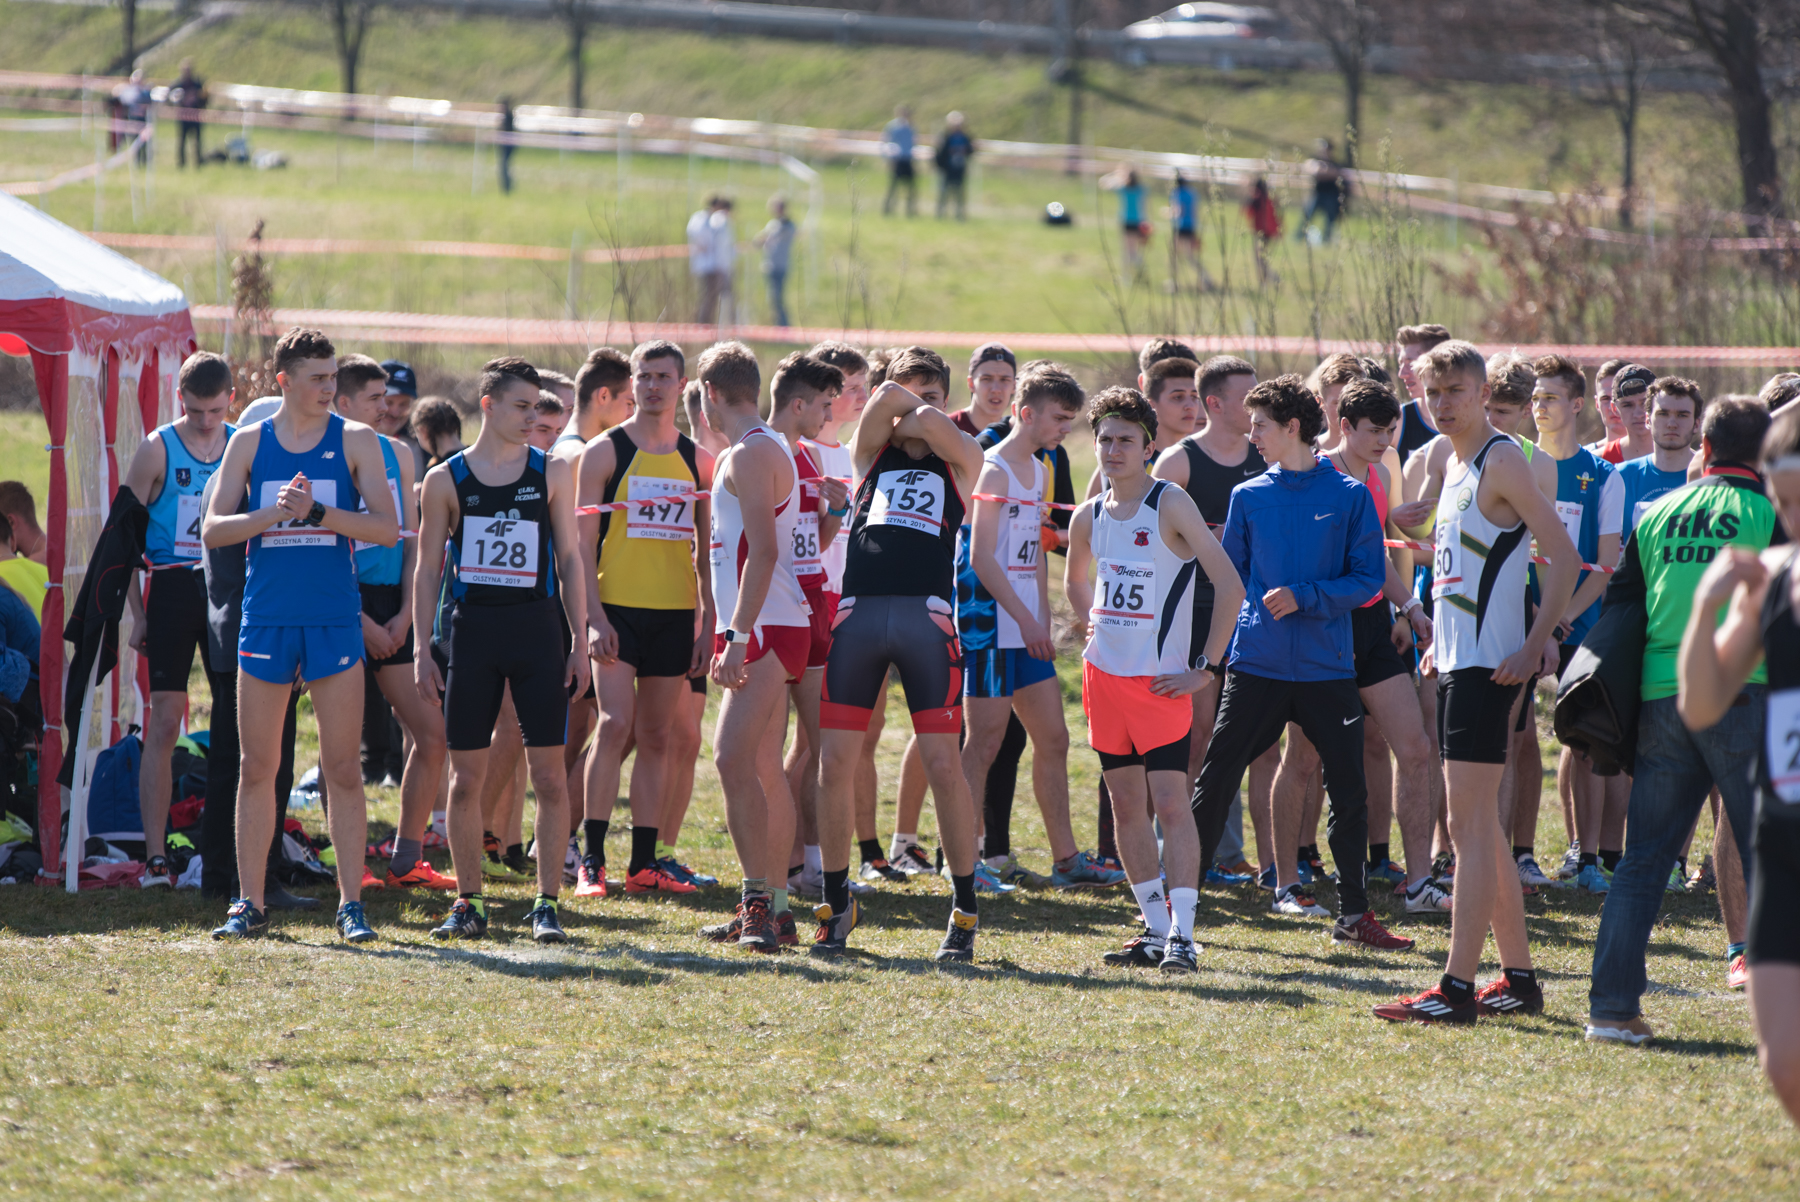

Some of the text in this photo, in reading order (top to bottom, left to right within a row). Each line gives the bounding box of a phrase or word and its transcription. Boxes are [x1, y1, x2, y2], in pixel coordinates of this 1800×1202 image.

[896, 471, 930, 486] 4F
[638, 499, 687, 524] 497
[885, 488, 935, 517] 152
[484, 520, 518, 537] 4F
[640, 530, 682, 540] OLSZYNA 2019
[910, 520, 926, 529] 2019
[1665, 508, 1741, 540] RKS
[475, 539, 527, 569] 128
[794, 532, 817, 558] 85
[1436, 547, 1453, 576] 50
[472, 575, 521, 585] OLSZYNA 2019
[1103, 581, 1144, 611] 165
[1099, 617, 1138, 628] OLSZYNA 2019
